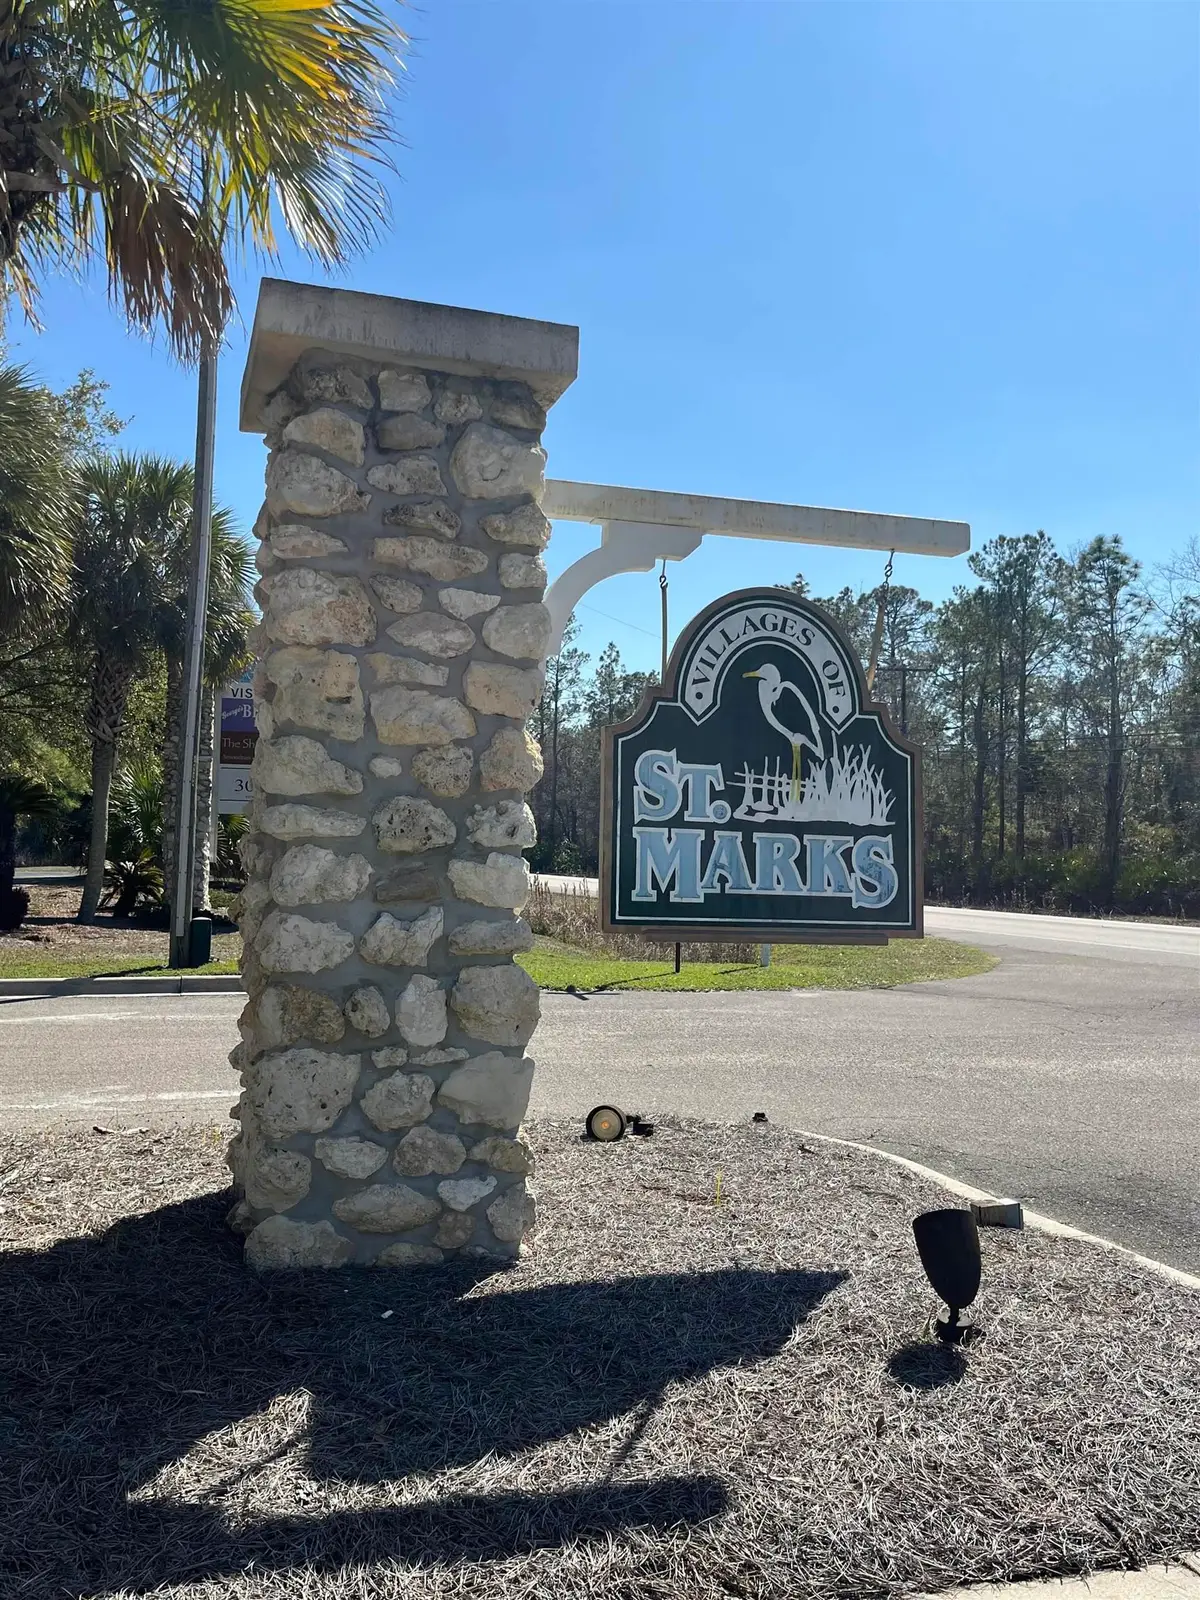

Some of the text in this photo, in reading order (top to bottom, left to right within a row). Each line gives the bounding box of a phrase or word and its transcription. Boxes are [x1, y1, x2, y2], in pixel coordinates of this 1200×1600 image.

[693, 612, 847, 698] VILLAGES OF
[222, 737, 241, 748] The
[633, 748, 732, 824] ST.
[631, 826, 899, 910] MARKS
